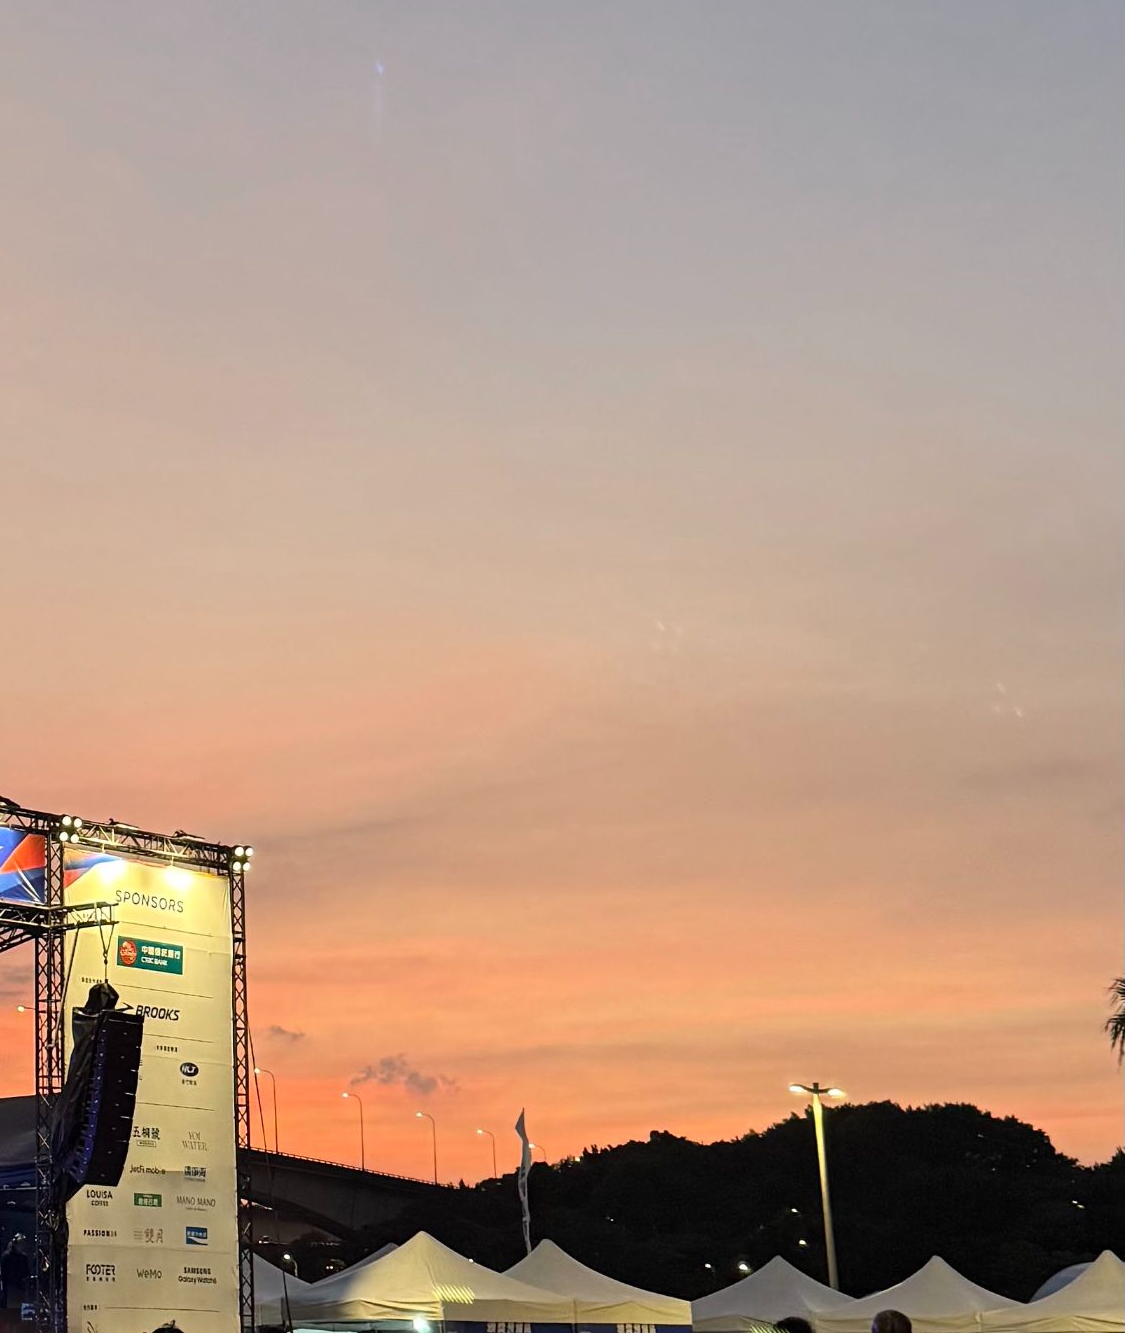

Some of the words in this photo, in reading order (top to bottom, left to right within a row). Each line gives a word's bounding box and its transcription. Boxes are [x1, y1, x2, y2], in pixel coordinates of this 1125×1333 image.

[115, 889, 184, 913] SPONSORS
[136, 1004, 180, 1021] BROOKS
[86, 1189, 113, 1199] LOUISA
[86, 1264, 115, 1275] FOOTER
[137, 1268, 163, 1279] WeMo
